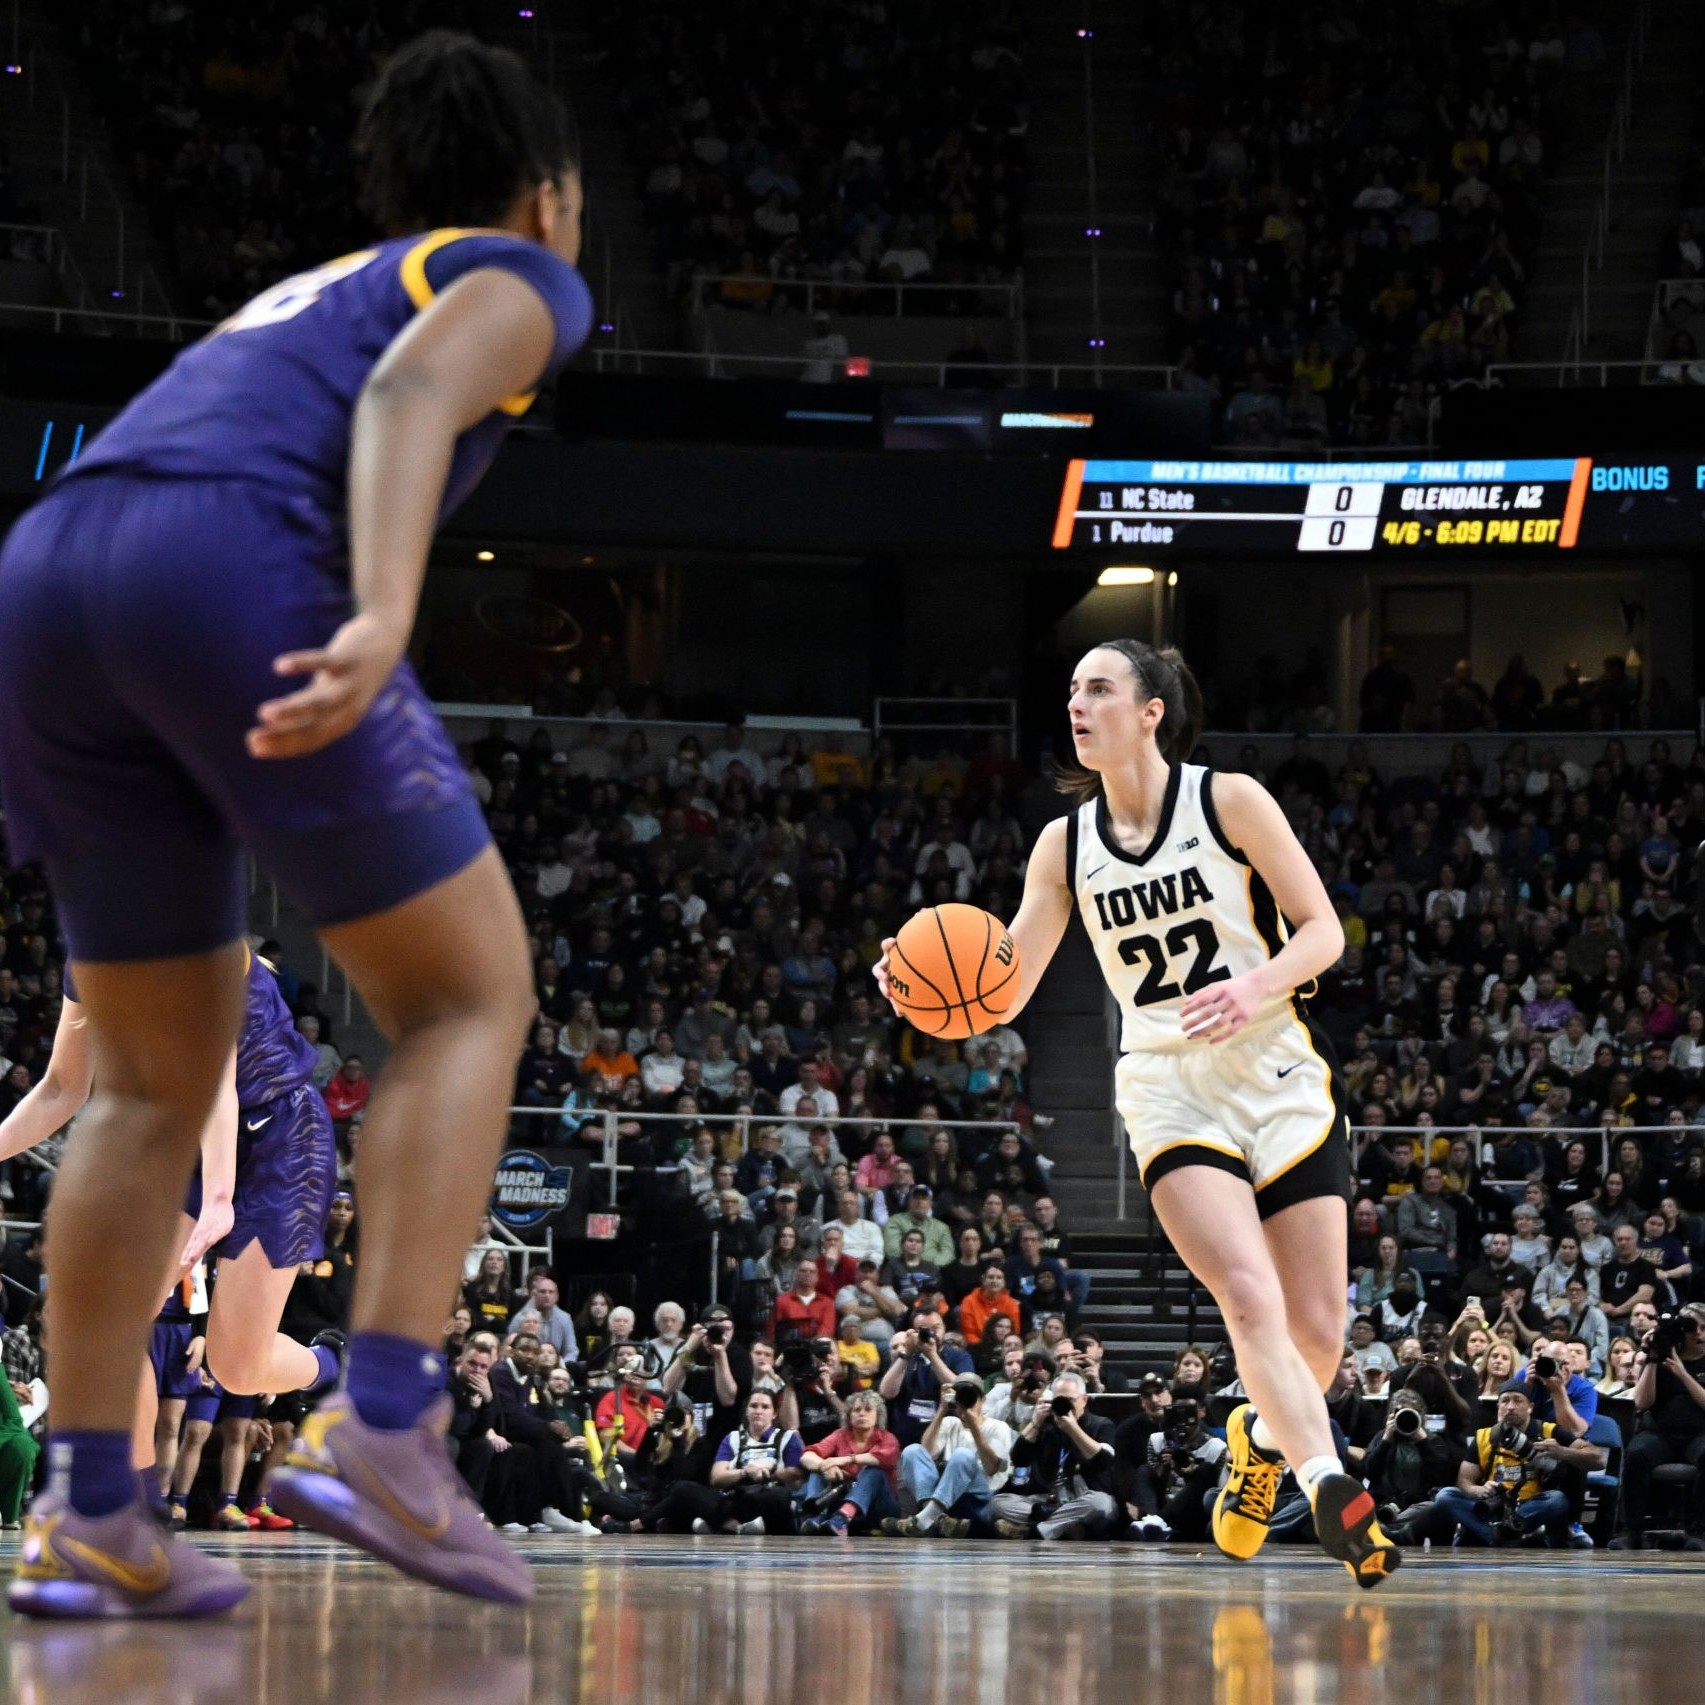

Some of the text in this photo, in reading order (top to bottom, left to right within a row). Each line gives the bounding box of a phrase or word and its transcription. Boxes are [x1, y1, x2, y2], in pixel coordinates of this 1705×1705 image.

[1152, 463, 1199, 481] MEN'S
[1200, 463, 1289, 482] BASKETBALL
[1294, 463, 1408, 482] CHAMPIONSHIP
[1419, 461, 1460, 480] FINAL
[1463, 460, 1506, 480] FOUR
[1592, 466, 1670, 491] BONUS
[1099, 488, 1195, 509] 11 NC State
[1335, 486, 1353, 511] 0
[1514, 486, 1544, 508] AZ
[1093, 521, 1174, 543] 1 Purdue
[1328, 521, 1345, 545] 0
[1382, 521, 1420, 544] 4/6
[1436, 521, 1482, 544] 6:09
[1486, 521, 1519, 543] PM
[1522, 520, 1560, 543] EDT
[1094, 866, 1214, 930] IOWA
[1117, 918, 1232, 1007] 22
[494, 1170, 545, 1186] MARCH
[499, 1186, 567, 1204] MADNESS
